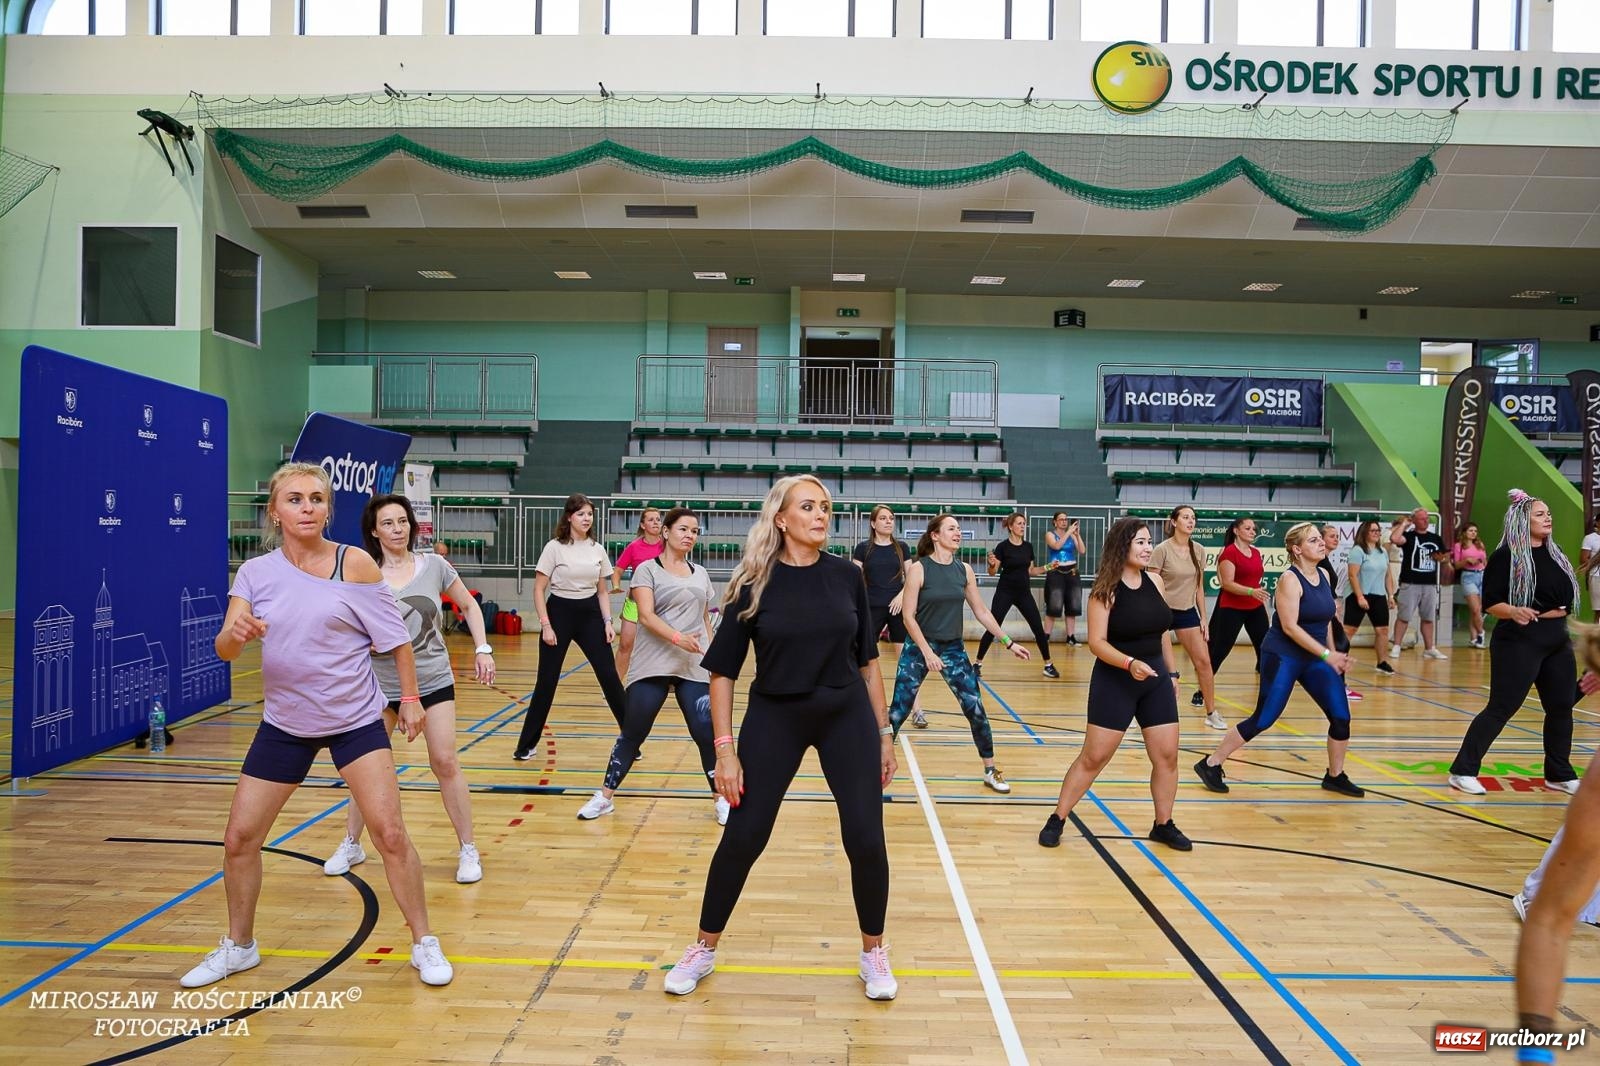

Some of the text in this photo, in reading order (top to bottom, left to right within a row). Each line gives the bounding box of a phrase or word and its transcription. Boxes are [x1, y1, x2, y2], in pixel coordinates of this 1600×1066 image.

[1185, 51, 1359, 96] OŚRODEK
[1373, 63, 1520, 99] SPORTU
[1533, 67, 1542, 99] I
[1125, 389, 1216, 407] RACIBÓRZ
[57, 415, 83, 428] Racibórz
[1522, 414, 1557, 422] RACIBÓRZ
[138, 429, 157, 440] Racibórz
[99, 517, 121, 526] Racibórz
